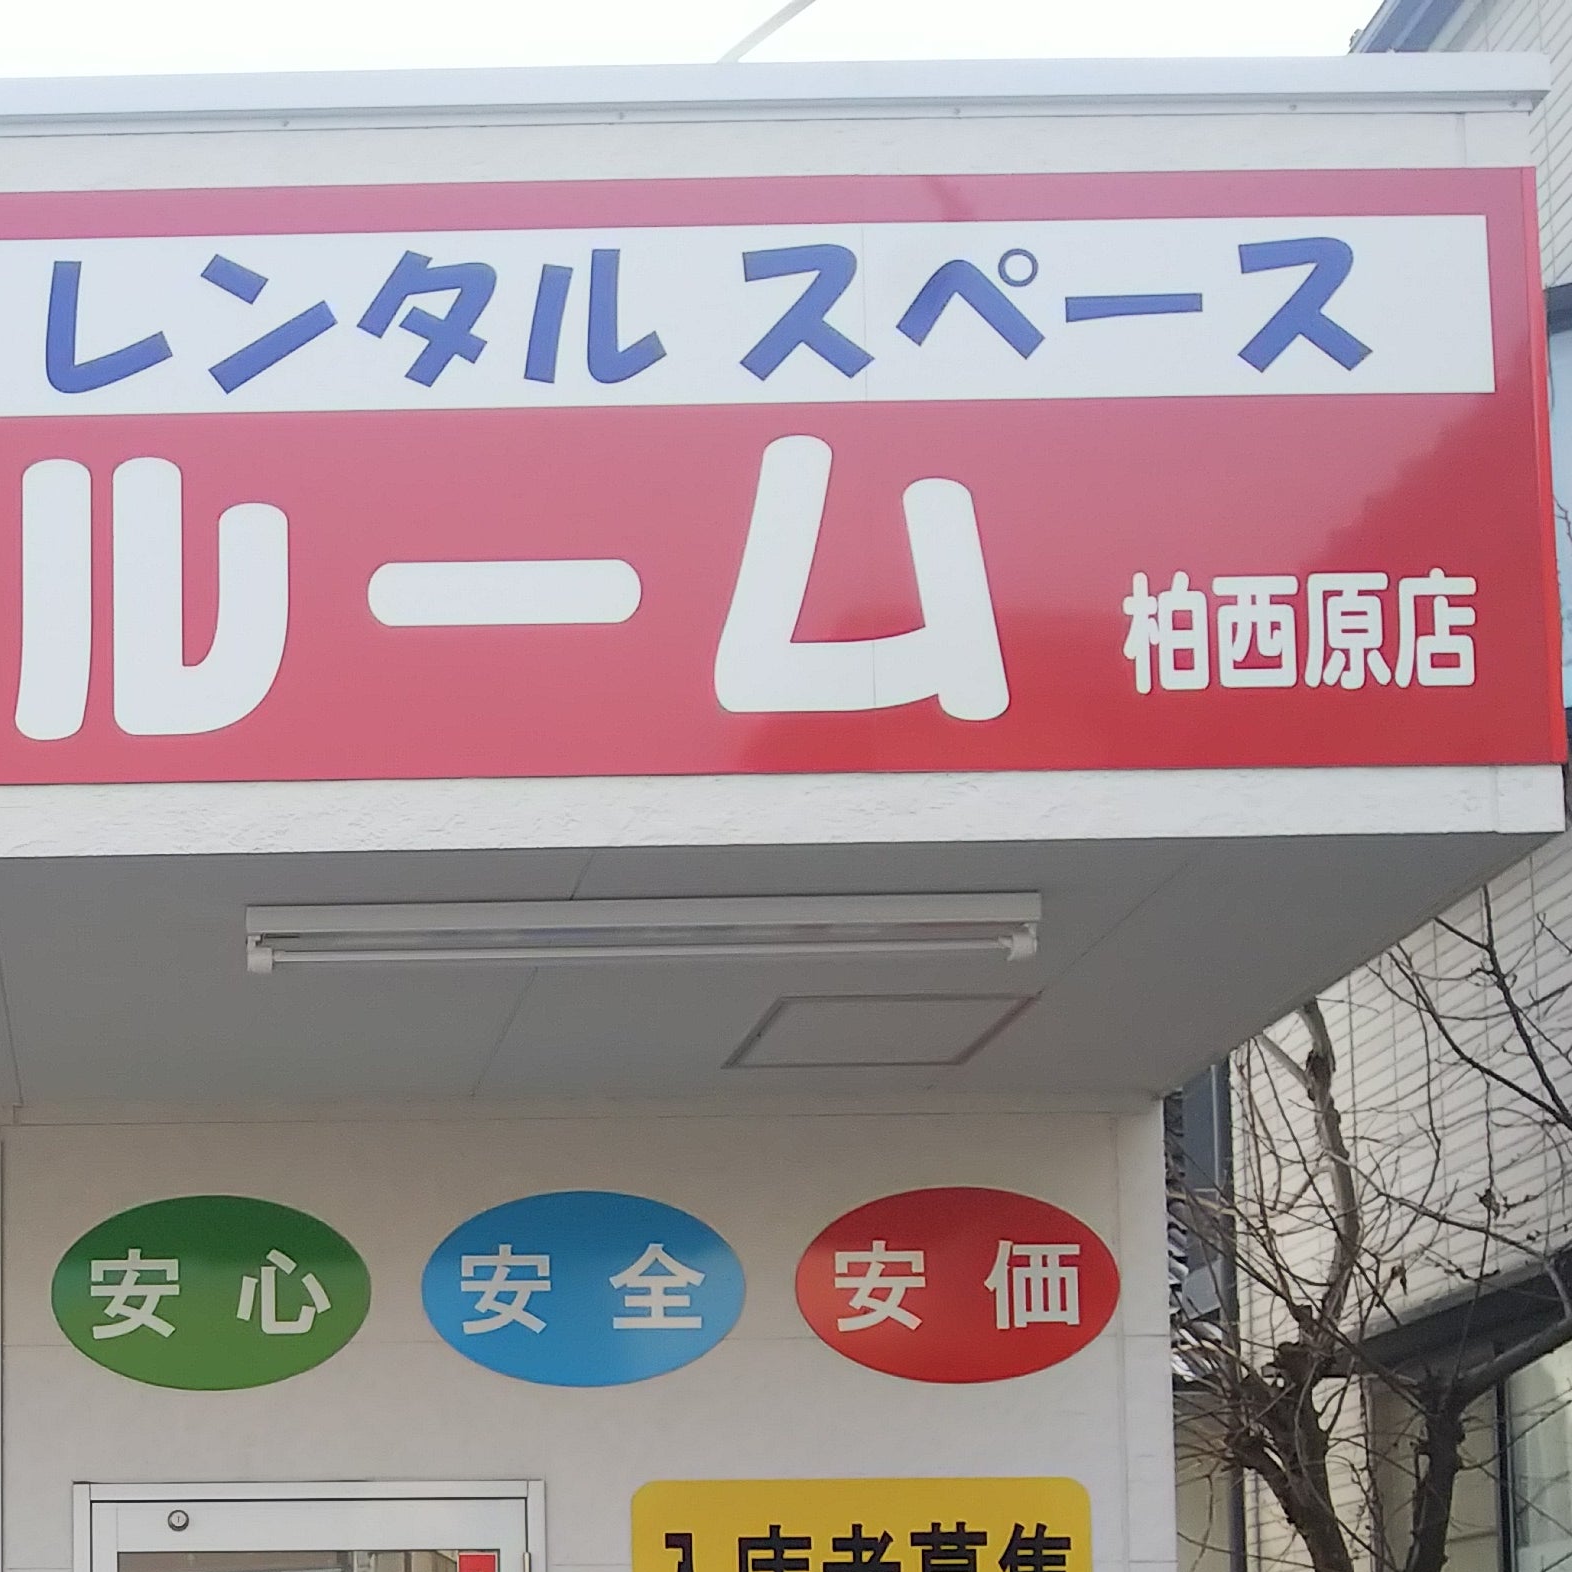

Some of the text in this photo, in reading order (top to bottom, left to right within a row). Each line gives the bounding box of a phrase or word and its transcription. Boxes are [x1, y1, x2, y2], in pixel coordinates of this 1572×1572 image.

[1122, 567, 1478, 693] 柏西原店
[89, 1247, 331, 1341] 安心
[460, 1243, 707, 1335] 安全
[833, 1239, 1081, 1332] 安価
